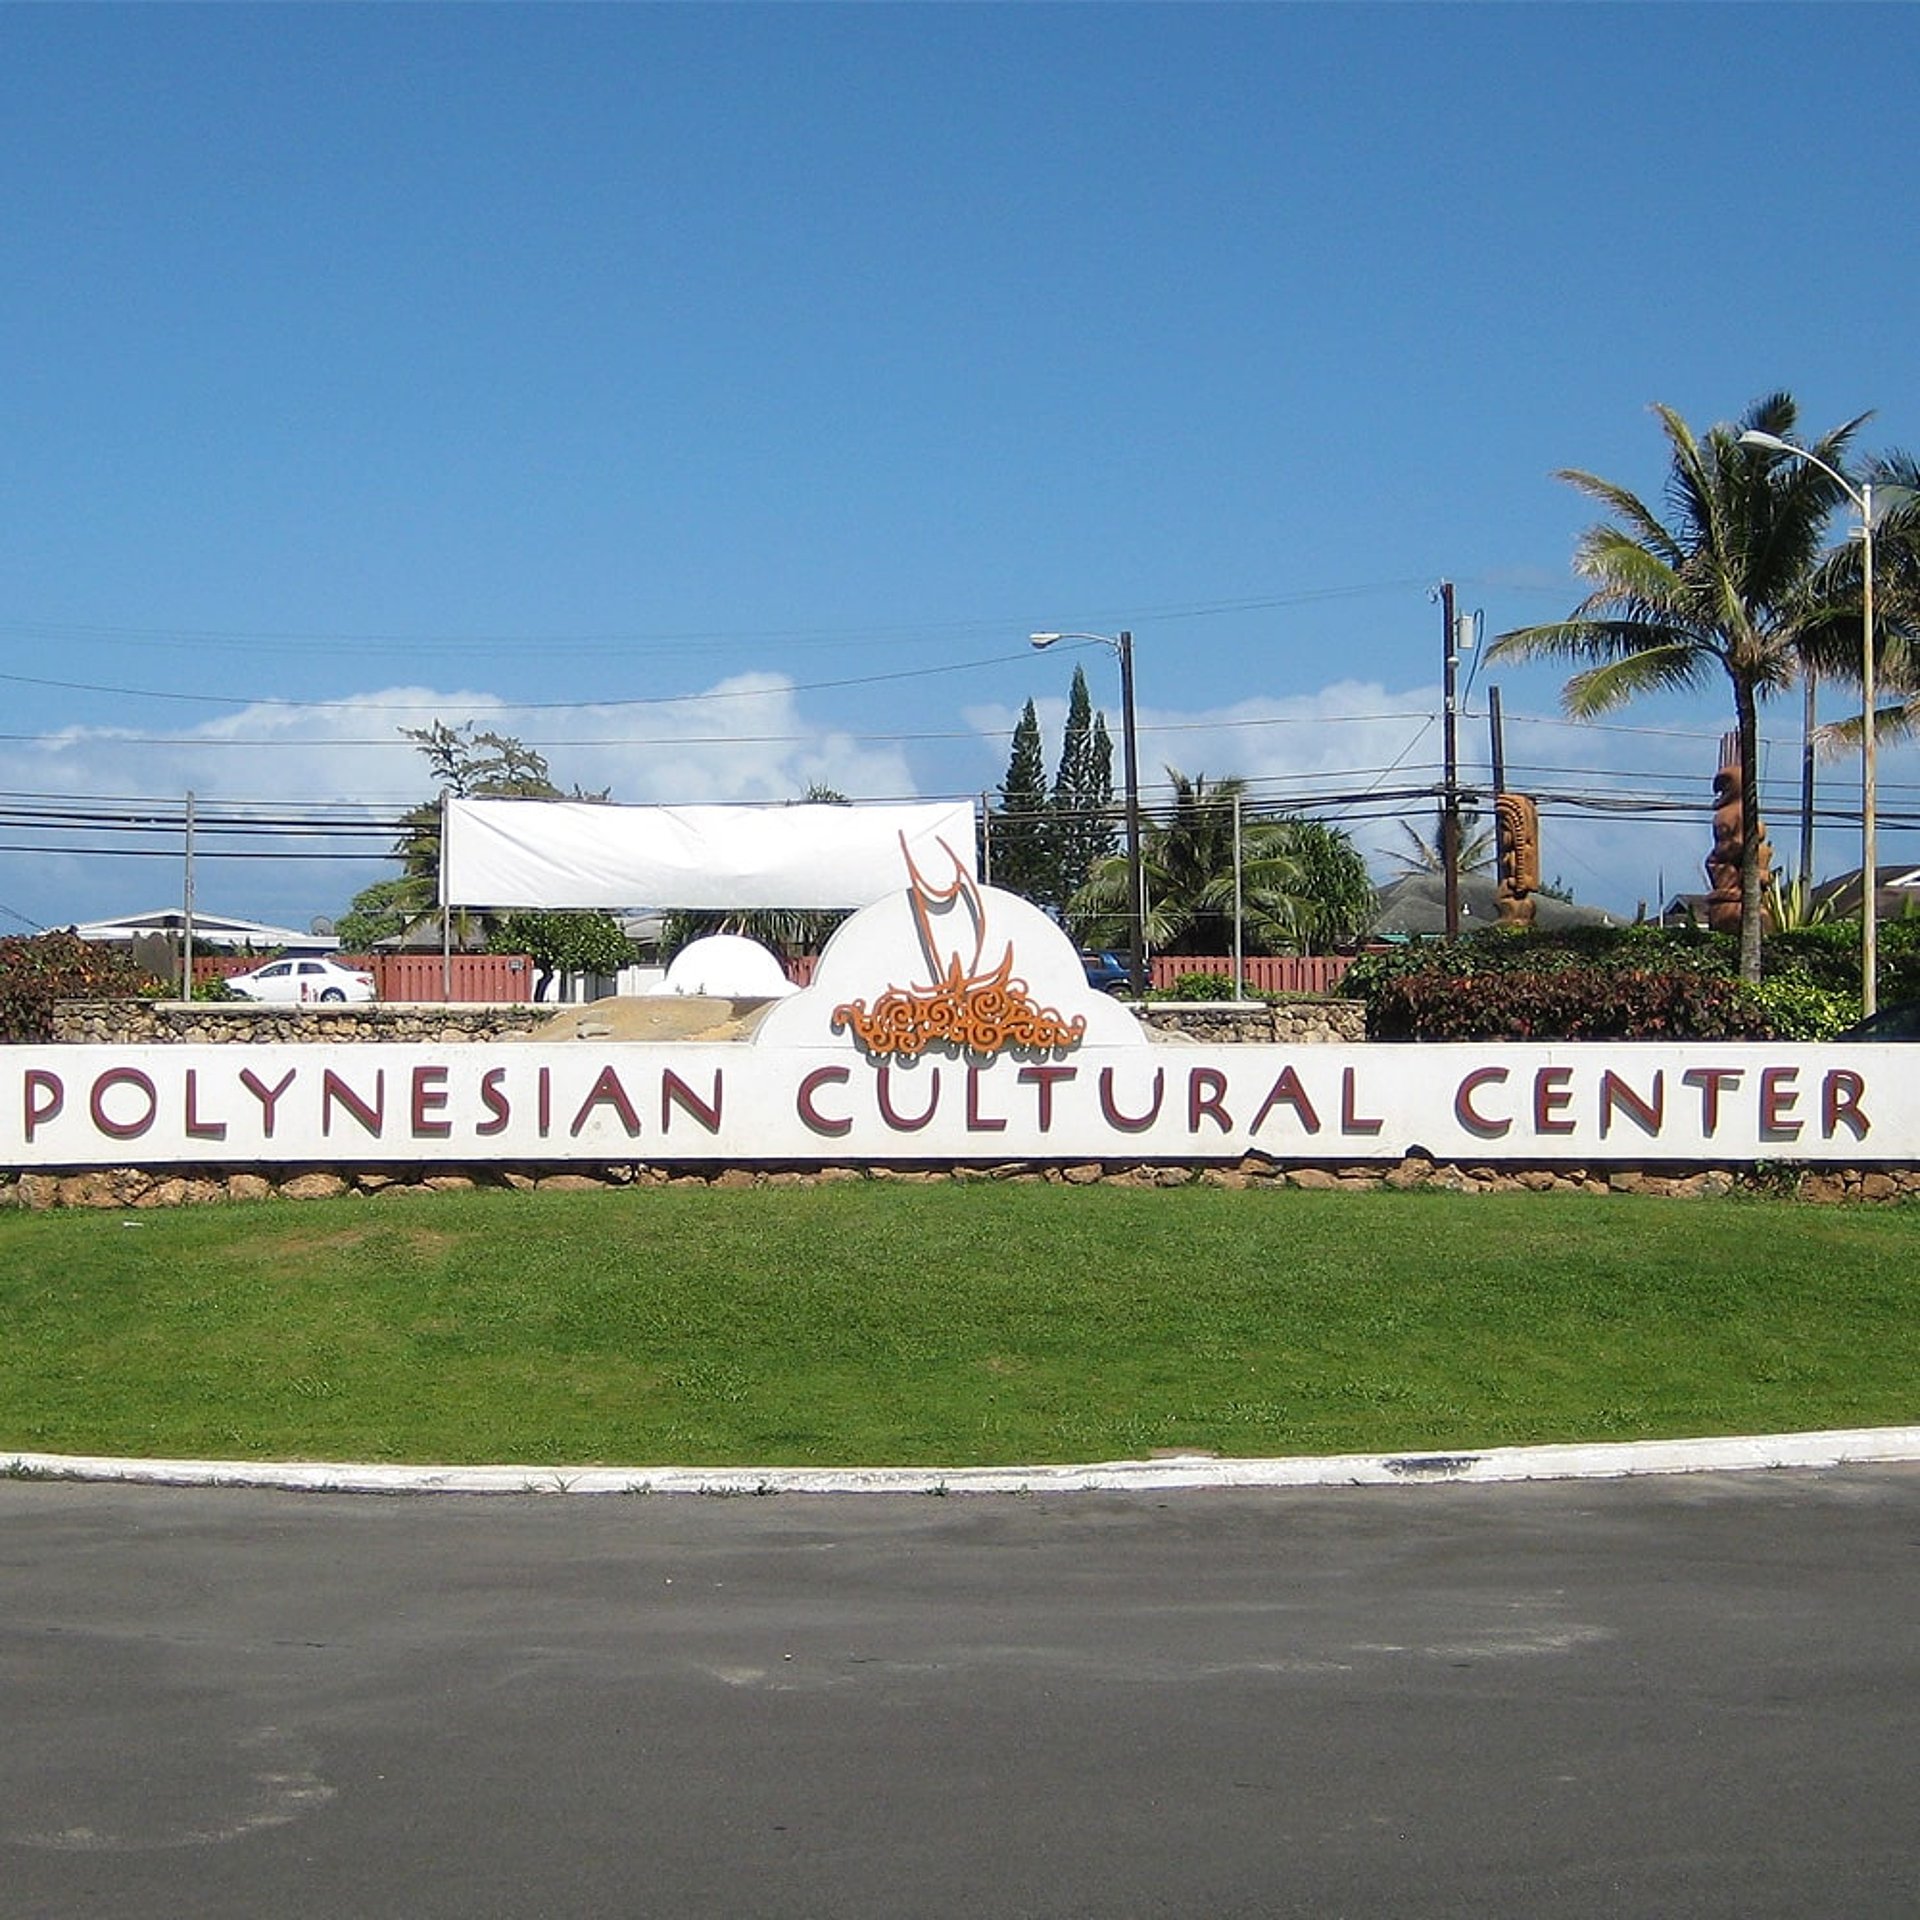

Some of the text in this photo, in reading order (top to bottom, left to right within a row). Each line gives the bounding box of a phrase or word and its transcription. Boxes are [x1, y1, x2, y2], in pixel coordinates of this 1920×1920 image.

[25, 1065, 1871, 1143] POLYNESIAN CULTURAL CENTER
